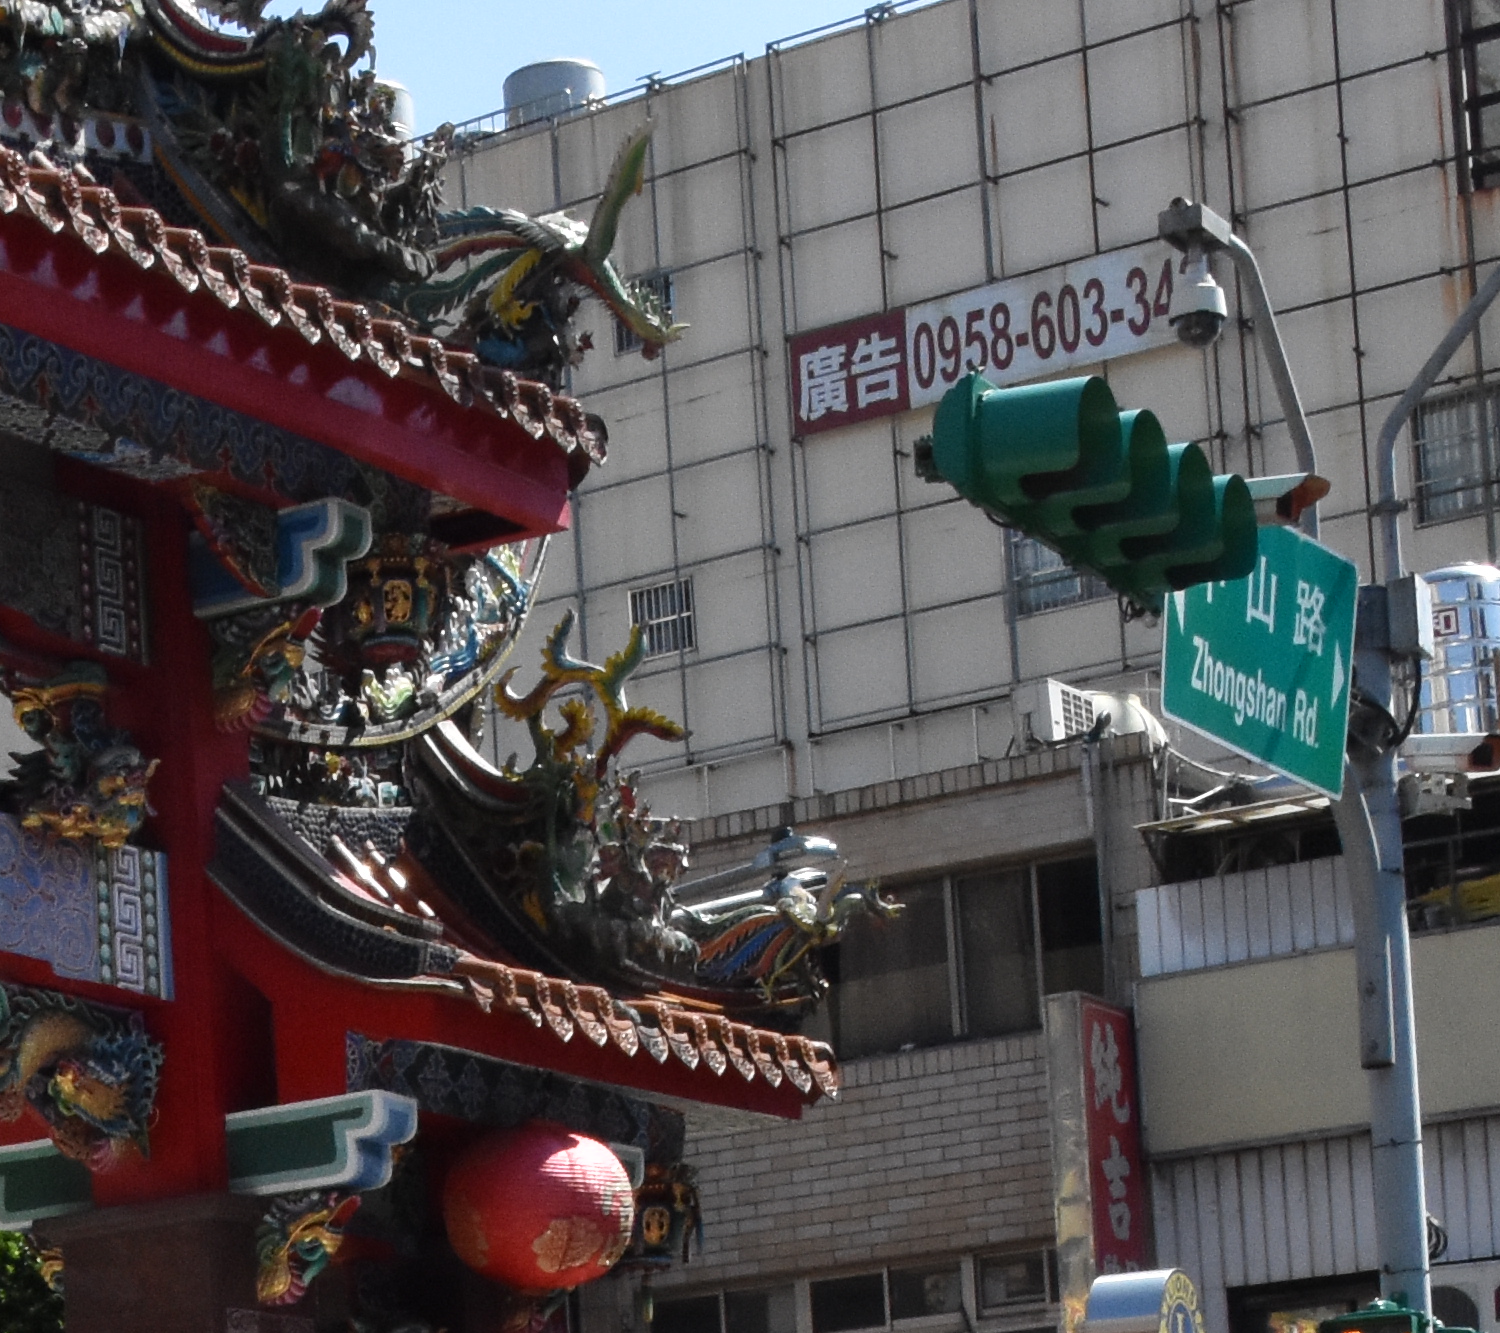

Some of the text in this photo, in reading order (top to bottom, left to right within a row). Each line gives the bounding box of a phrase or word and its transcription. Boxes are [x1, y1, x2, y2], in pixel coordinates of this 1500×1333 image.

[798, 254, 1195, 422] 廣告 0958-603-34
[1203, 556, 1327, 657] 山路
[1191, 635, 1320, 749] Zhongshan Rd.
